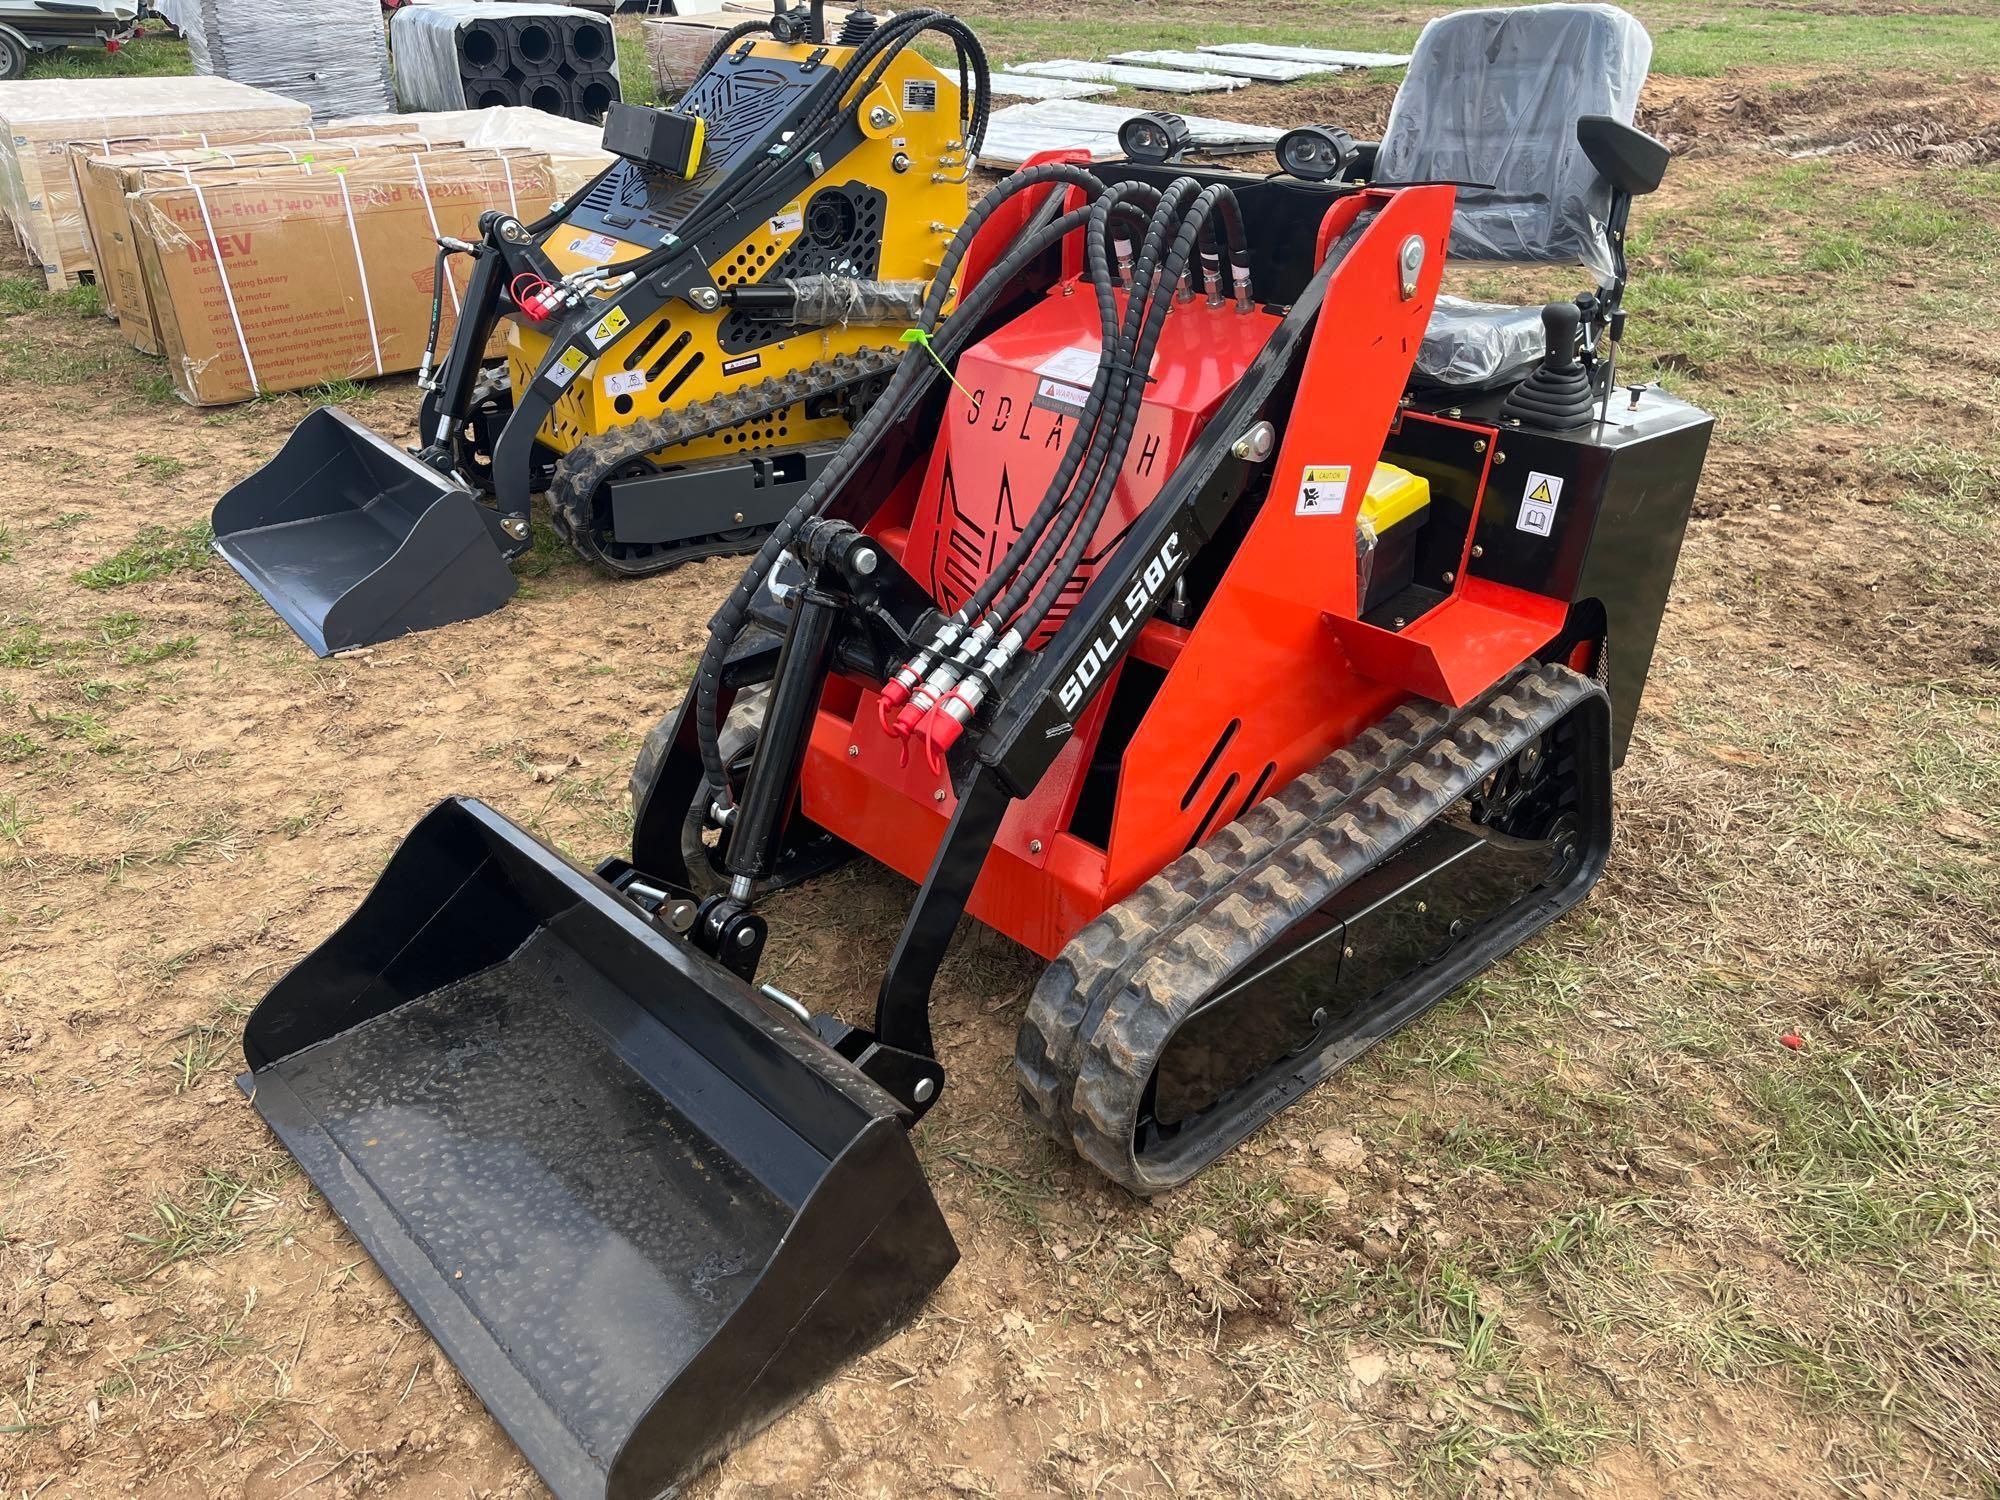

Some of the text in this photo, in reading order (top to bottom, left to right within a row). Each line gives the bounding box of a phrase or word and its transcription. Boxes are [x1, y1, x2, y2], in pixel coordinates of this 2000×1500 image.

[226, 258, 258, 270] vehicle
[257, 275, 288, 285] battery
[203, 292, 271, 307] Poweul motor
[241, 307, 263, 316] steel
[264, 303, 290, 312] frame
[261, 315, 294, 328] painted
[295, 311, 323, 322] plastic
[325, 306, 345, 317] shell
[292, 326, 312, 336] dual
[313, 322, 343, 333] remote
[219, 353, 237, 362] LED
[239, 347, 274, 360] dytime
[276, 342, 310, 353] running
[338, 332, 367, 343] energy
[224, 358, 295, 376] envirnmentally
[333, 347, 352, 358] long
[1055, 388, 1087, 404] WARNING
[1318, 471, 1341, 480] CAUTION
